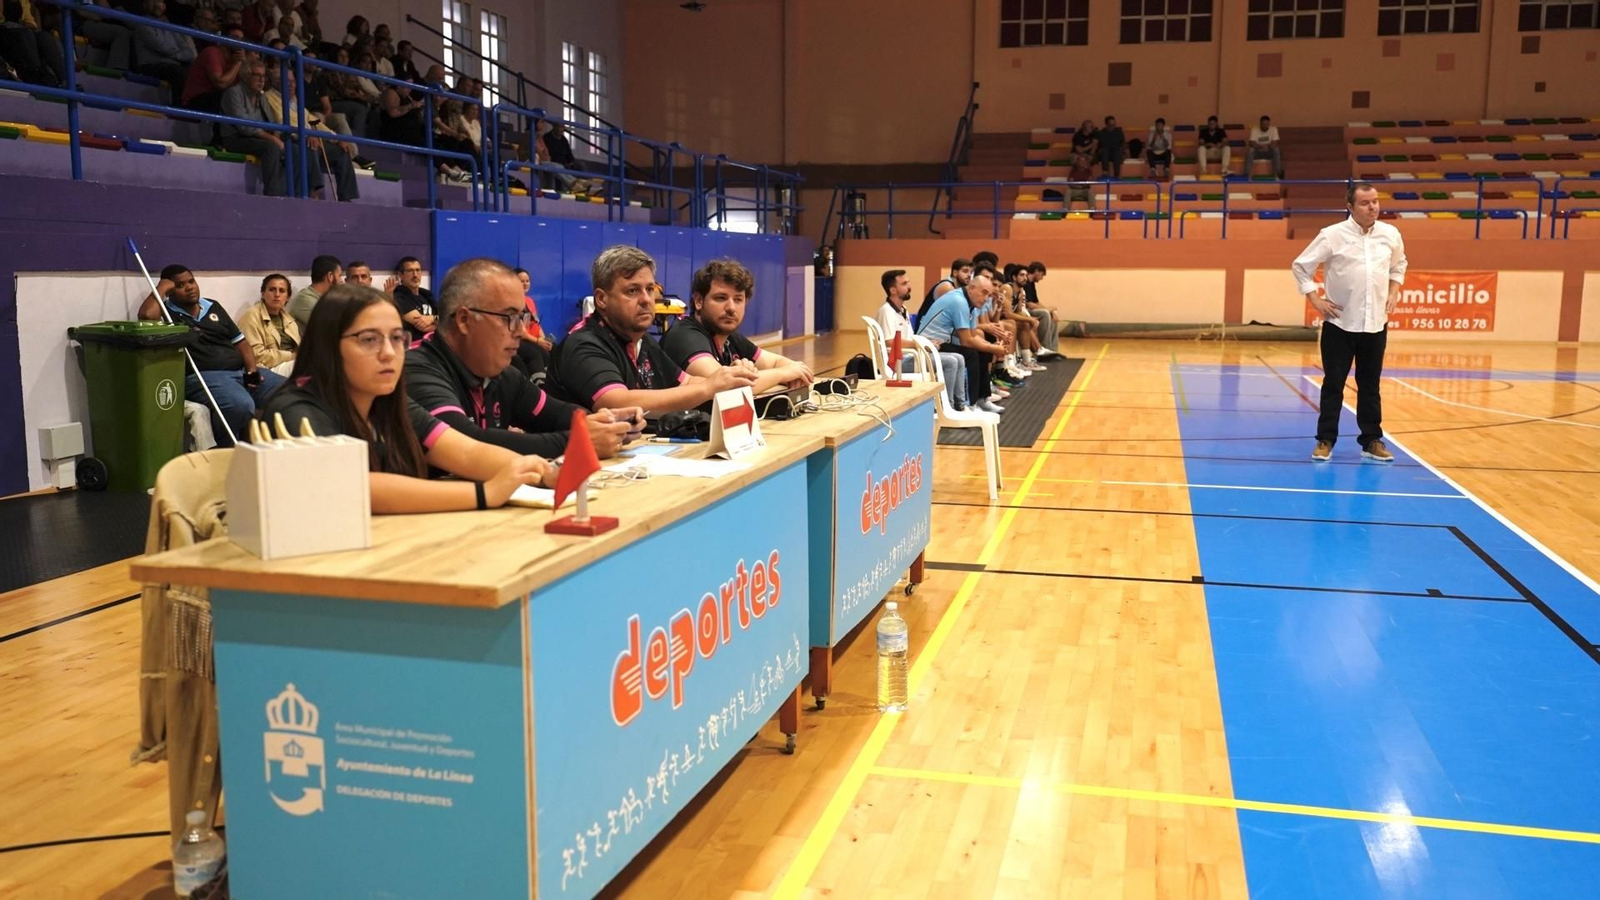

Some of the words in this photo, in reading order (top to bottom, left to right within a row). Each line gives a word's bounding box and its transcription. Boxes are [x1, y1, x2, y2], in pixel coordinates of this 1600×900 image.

[1396, 283, 1490, 304] micilio
[1412, 318, 1434, 329] 956
[1438, 318, 1451, 329] 10
[1454, 318, 1469, 329] 28
[1473, 318, 1487, 329] 78
[861, 452, 922, 535] deportes
[610, 549, 781, 727] deportes
[394, 729, 406, 739] de
[337, 758, 411, 776] Ayuntamiento
[412, 767, 426, 778] de
[428, 769, 442, 779] La
[393, 791, 404, 801] DE
[406, 793, 453, 807] DEPORTES
